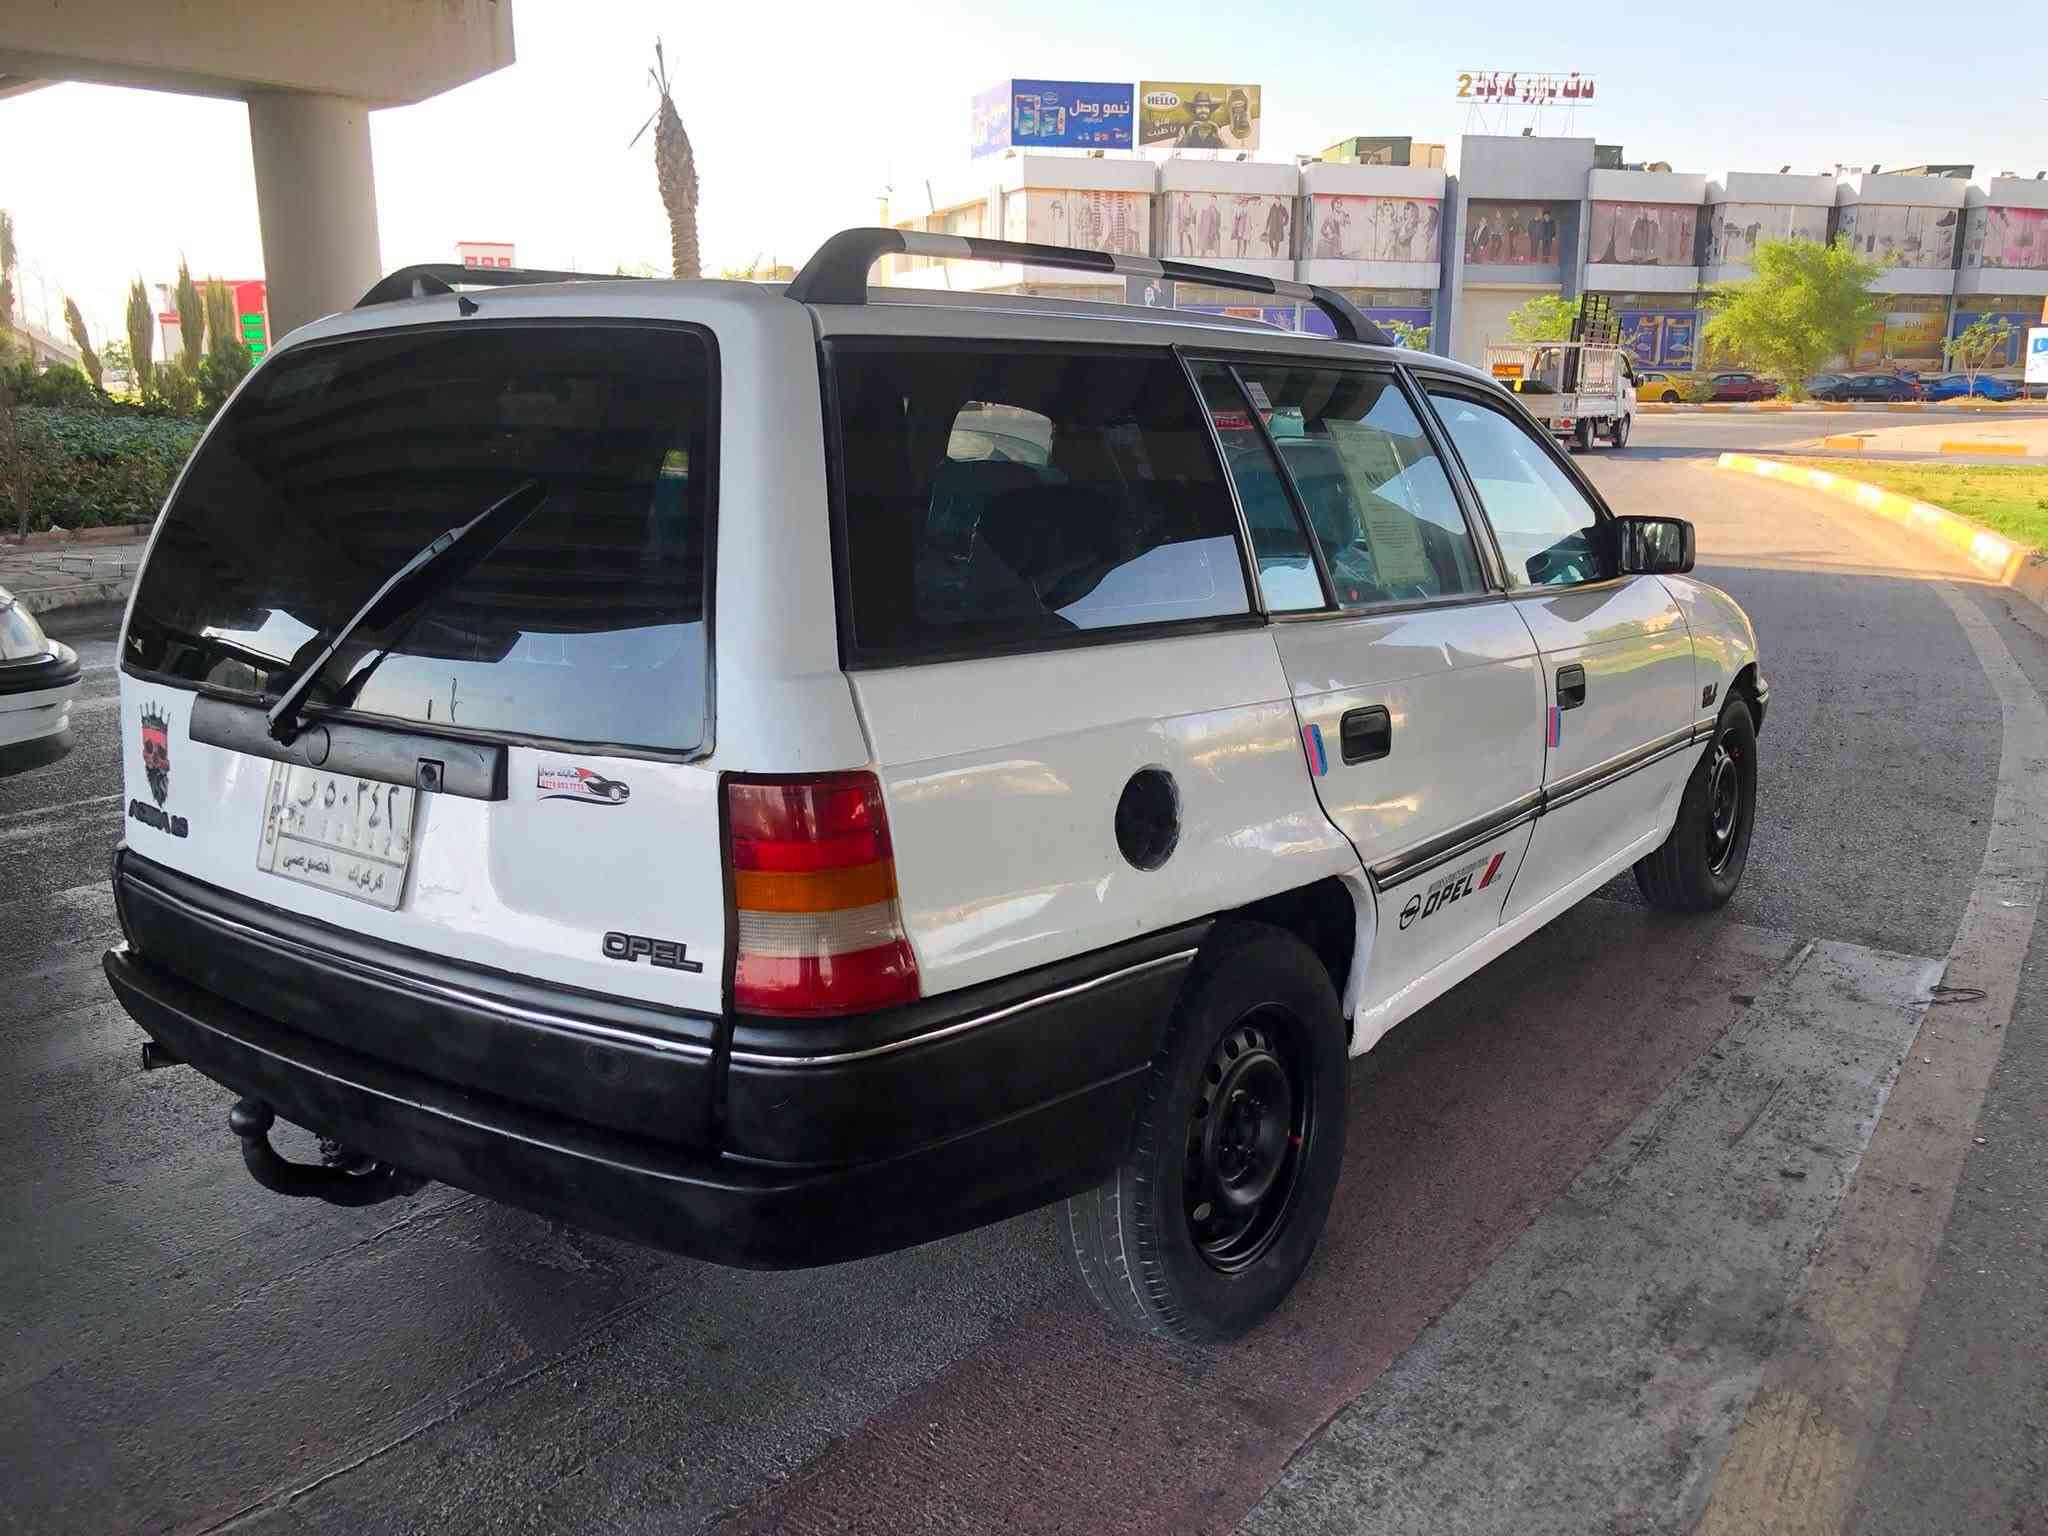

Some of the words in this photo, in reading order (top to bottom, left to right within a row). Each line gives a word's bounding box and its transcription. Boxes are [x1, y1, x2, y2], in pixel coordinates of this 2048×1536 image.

[1147, 95, 1177, 106] HELLO
[1458, 74, 1473, 97] 2
[1421, 873, 1474, 919] OPEL
[602, 931, 703, 974] OPEL
